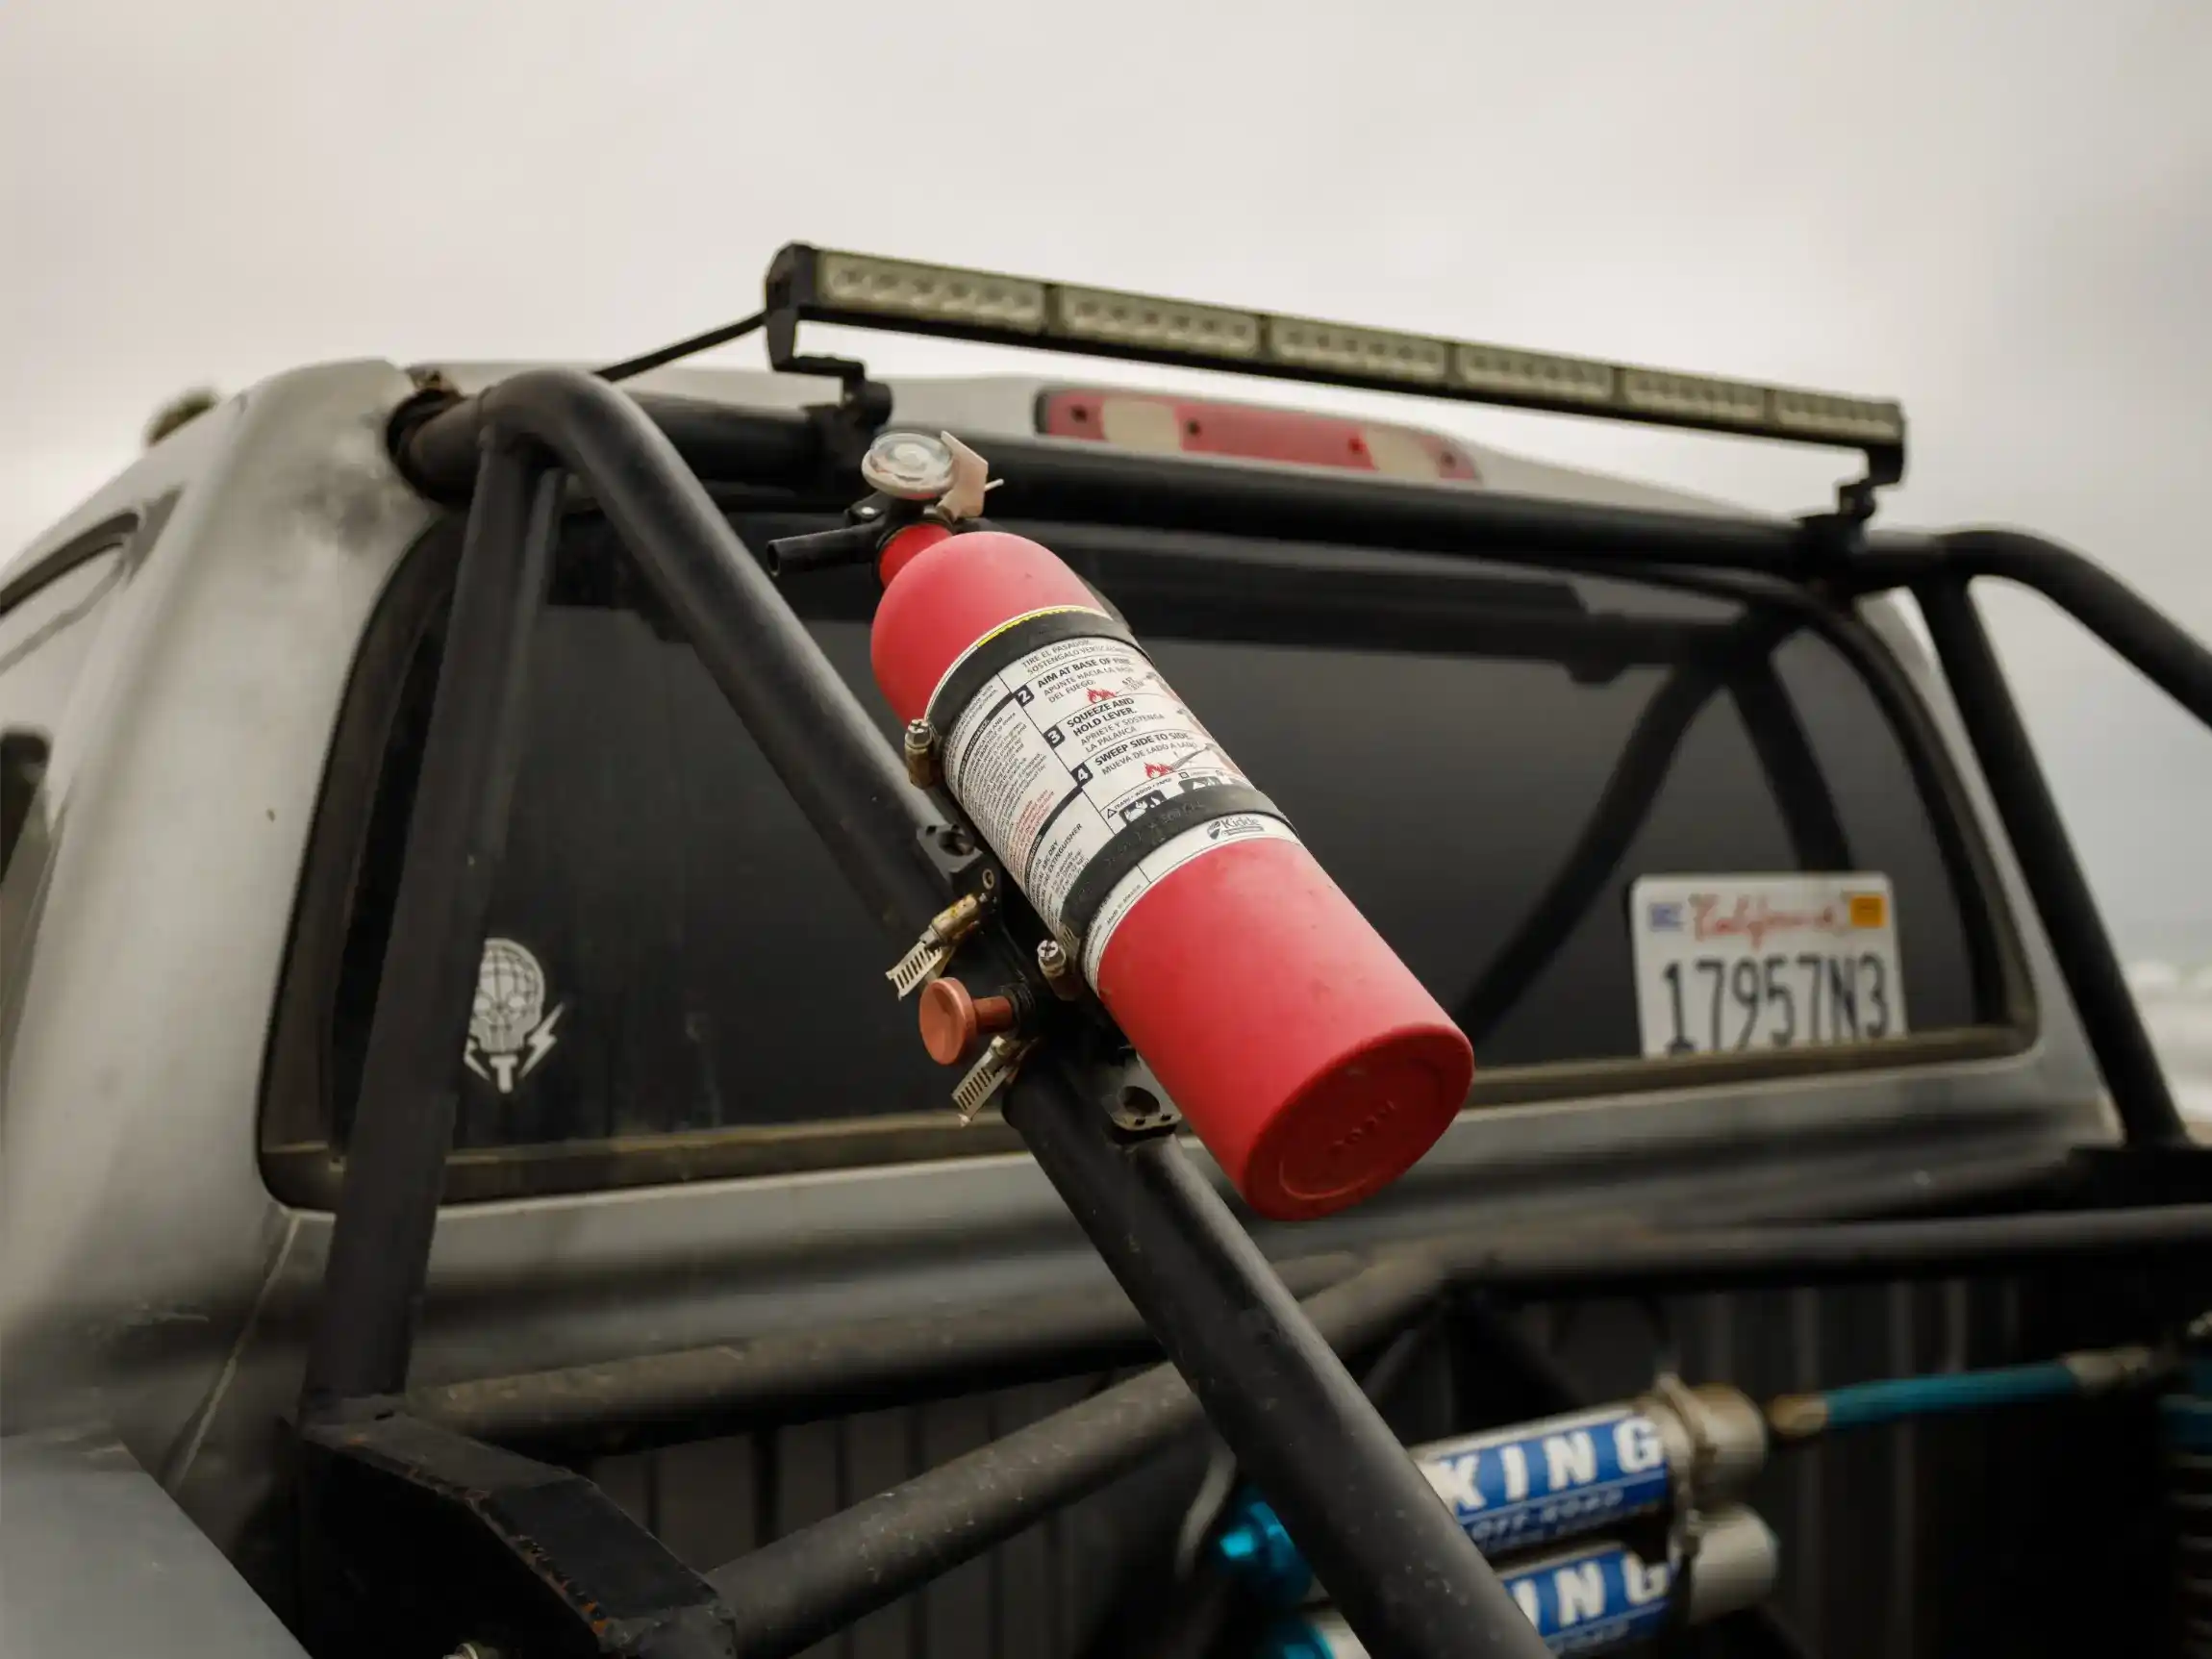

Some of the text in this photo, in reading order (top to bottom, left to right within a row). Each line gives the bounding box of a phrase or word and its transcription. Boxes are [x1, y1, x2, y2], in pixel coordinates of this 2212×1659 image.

[1041, 649, 1052, 658] EL
[1038, 672, 1058, 688] AIM
[1059, 666, 1071, 676] AT
[1071, 658, 1098, 671] BASE
[1099, 657, 1112, 666] OF
[1018, 690, 1031, 703] 2
[1043, 676, 1076, 696] APUNTE
[1048, 679, 1096, 703] DEL FUEGO.
[1067, 697, 1135, 728] SQUEEZE AND
[1072, 707, 1138, 737] HOLD LEVER.
[1047, 730, 1062, 745] 3
[1080, 723, 1115, 745] APRIETE
[1085, 726, 1137, 753] LA PALANCA
[1095, 744, 1129, 766] SWEEP
[1130, 735, 1155, 748] SIDE
[1155, 733, 1169, 742] TO
[1101, 755, 1133, 775] MUEVA
[1134, 750, 1146, 760] DE
[1146, 744, 1169, 756] LADO
[1077, 767, 1089, 781] 4
[1221, 816, 1260, 830] Kidde
[1048, 823, 1082, 872] EXTINGUISHER
[1048, 840, 1058, 856] DRY
[1664, 951, 1891, 1055] 17957N3
